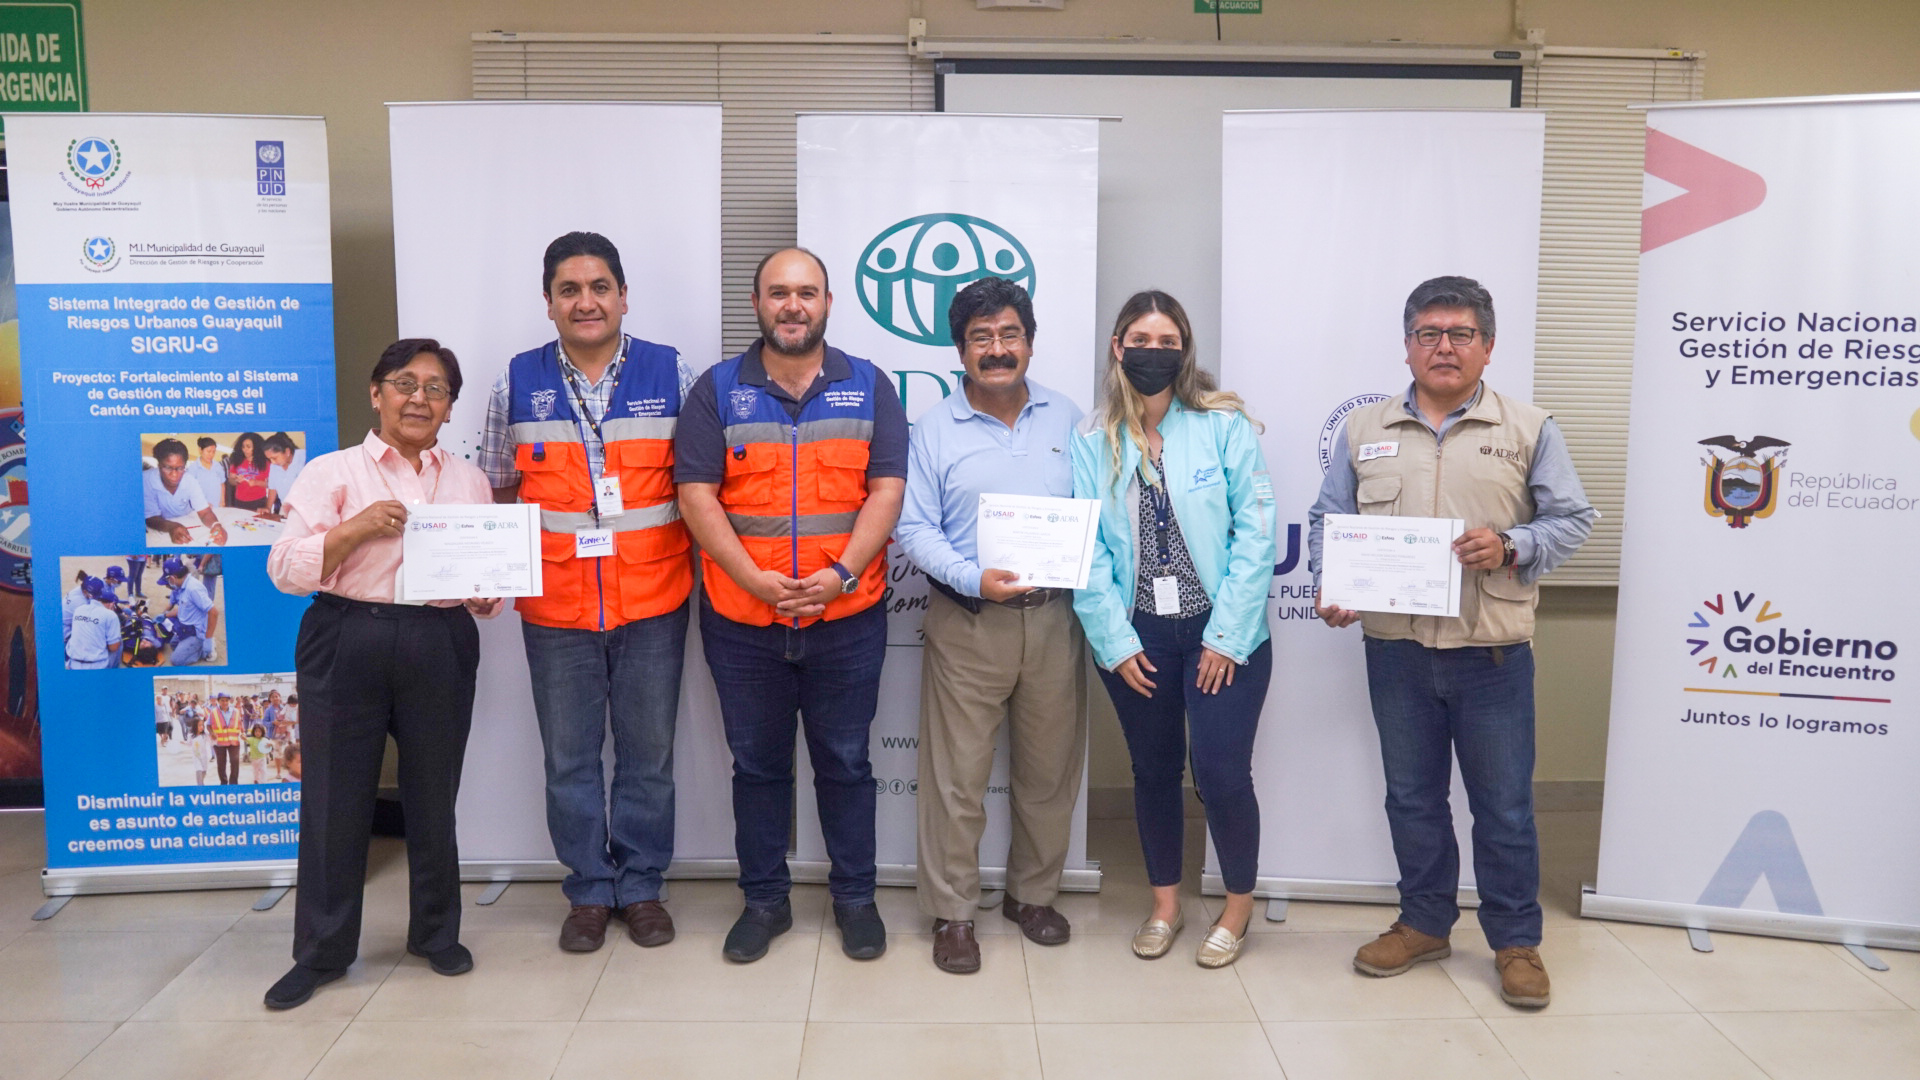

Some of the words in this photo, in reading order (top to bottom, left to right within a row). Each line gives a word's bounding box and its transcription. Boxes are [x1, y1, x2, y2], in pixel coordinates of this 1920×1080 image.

[36, 33, 61, 62] DE
[147, 243, 203, 254] Municipalidad
[205, 243, 217, 252] de
[220, 243, 265, 254] Guayaquil
[226, 258, 263, 266] Cooperación
[48, 297, 110, 311] Sistema
[113, 296, 188, 313] Integrado
[191, 296, 210, 310] de
[214, 295, 276, 310] Gestión
[280, 296, 300, 310] de
[67, 316, 130, 332] Riesgos
[134, 315, 198, 329] Urbanos
[202, 315, 283, 332] Guayaquil
[1672, 311, 1786, 332] Servicio
[1797, 311, 1920, 333] Naciona
[131, 335, 219, 354] SIGRU-G
[1679, 338, 1787, 359] Gestión
[1798, 338, 1833, 359] de
[52, 372, 116, 386] Proyecto:
[120, 371, 224, 383] Fortalecimiento
[227, 371, 239, 382] al
[243, 370, 299, 382] Sistema
[1705, 369, 1721, 388] y
[1731, 365, 1919, 390] Emergencias
[88, 388, 104, 400] de
[108, 388, 162, 400] Gestión
[166, 388, 181, 399] de
[185, 387, 237, 402] Riesgos
[242, 387, 263, 399] del
[90, 404, 139, 417] Cantón
[143, 403, 213, 418] Guayaquil,
[216, 403, 254, 414] FASE
[258, 403, 266, 414] II
[1326, 402, 1355, 431] UNITED
[1492, 448, 1520, 462] ADRA
[1790, 472, 1898, 492] República
[1787, 491, 1819, 507] del
[1827, 492, 1920, 511] Ecuador
[992, 510, 1015, 518] USAID
[1059, 515, 1079, 523] ADRA
[1342, 532, 1368, 540] USAID
[1418, 536, 1440, 544] ADRA
[1723, 625, 1898, 661] Gobierno
[1747, 661, 1773, 675] del
[1779, 659, 1896, 682] Encuentro
[1680, 709, 1751, 727] Juntos
[1759, 712, 1778, 729] lo
[1786, 714, 1889, 736] logramos
[78, 792, 164, 810] Disminuir
[170, 791, 185, 806] la
[89, 818, 110, 831] es
[116, 814, 177, 830] asunto
[182, 812, 203, 827] de
[208, 808, 299, 826] actualidad
[68, 839, 145, 853] creemos
[150, 837, 183, 850] una
[188, 831, 247, 848] ciudad
